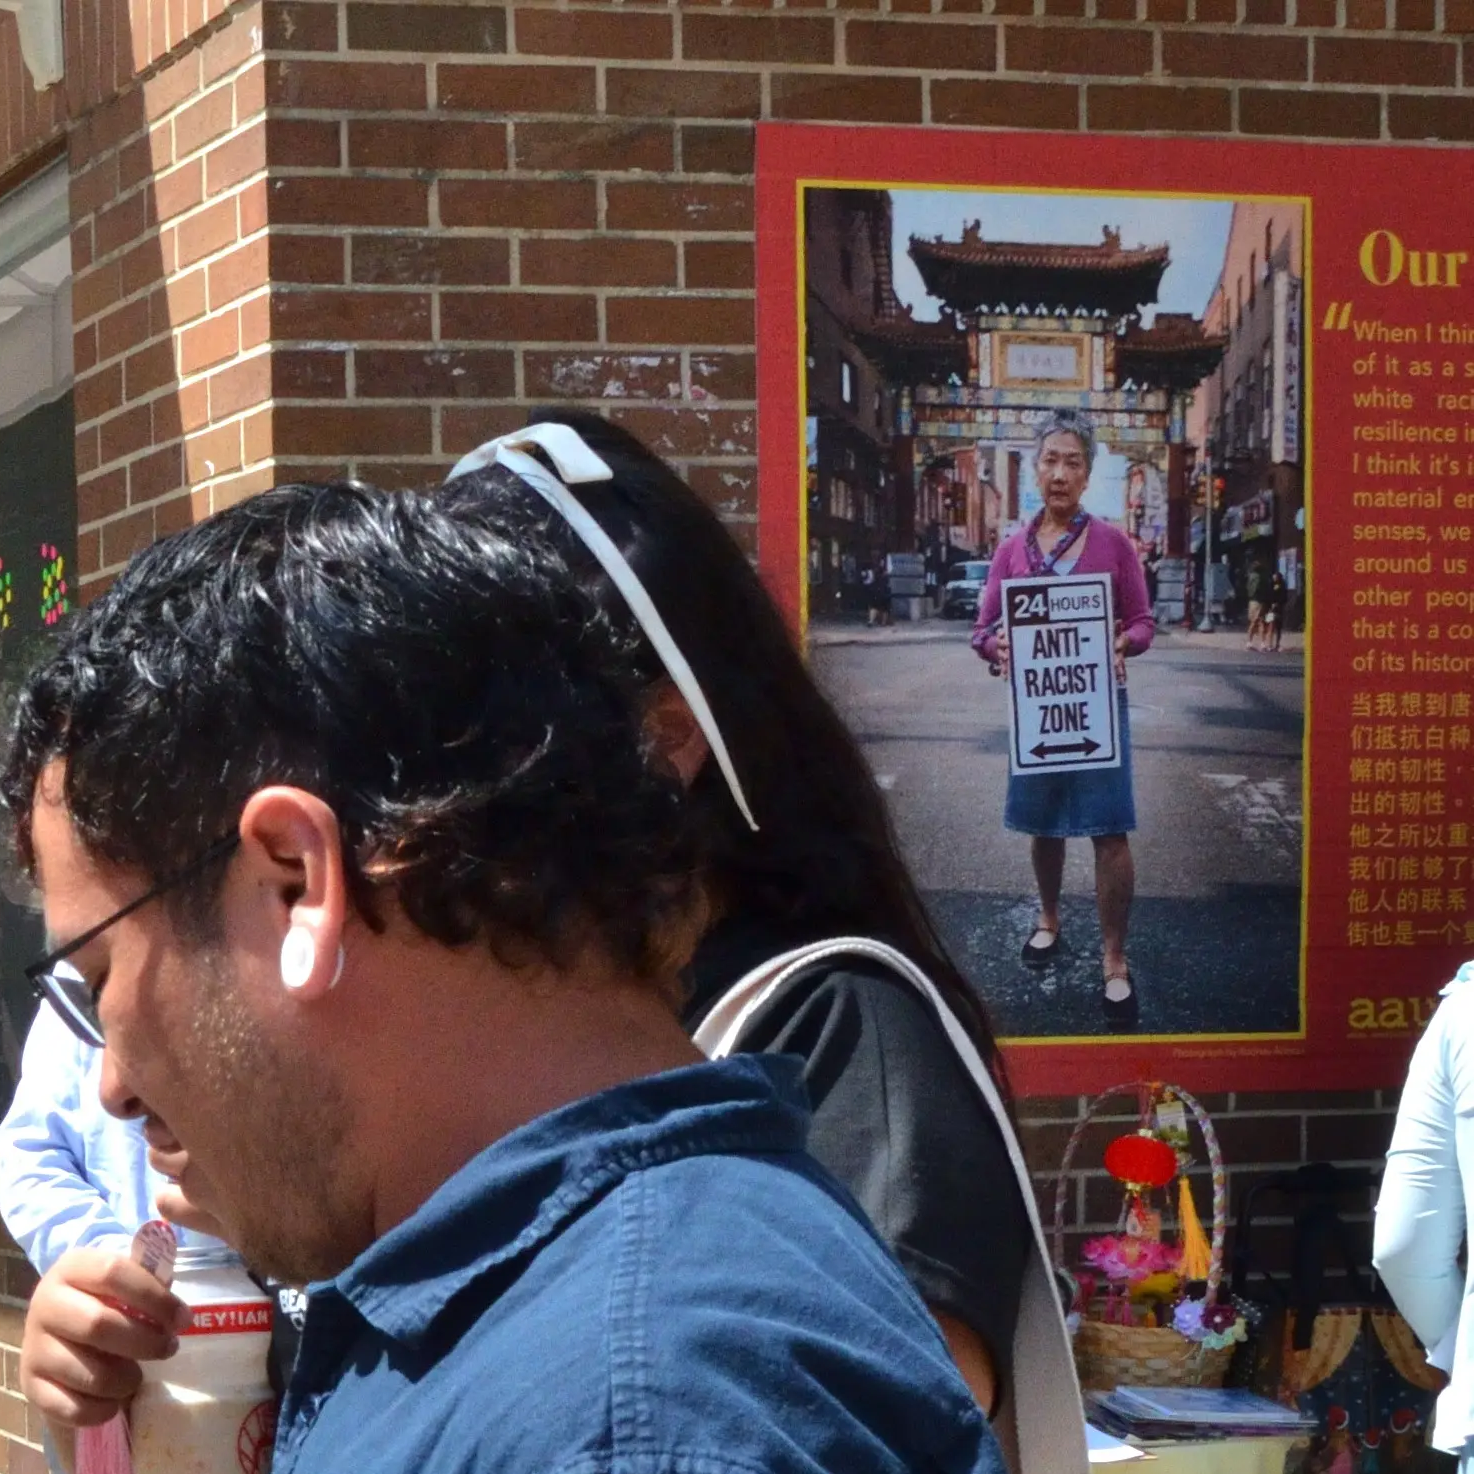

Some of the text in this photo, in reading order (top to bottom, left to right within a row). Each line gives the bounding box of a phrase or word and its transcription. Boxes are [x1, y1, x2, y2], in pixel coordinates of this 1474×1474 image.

[1359, 229, 1469, 287] Our
[1354, 320, 1417, 343] When
[1426, 322, 1432, 344] I
[1353, 352, 1377, 375] of
[1385, 354, 1399, 375] it
[1408, 360, 1432, 376] as
[1442, 361, 1454, 376] a
[1353, 386, 1414, 409] white
[1353, 420, 1457, 442] resilience
[1366, 452, 1420, 475] think
[1429, 453, 1459, 476] it's
[1353, 487, 1443, 508] material
[1353, 524, 1471, 544] senses, we
[1353, 552, 1467, 574] around us
[1014, 593, 1102, 619] 24 HOURS
[1353, 584, 1412, 606] other
[1352, 617, 1395, 640] that
[1403, 619, 1419, 640] is
[1427, 624, 1440, 639] a
[1032, 626, 1091, 660] ANTI-
[1353, 649, 1375, 672] of
[1381, 651, 1404, 672] its
[1024, 663, 1099, 698] RACIST
[1038, 702, 1090, 735] ZONE
[1348, 855, 1474, 881] 我们能够了
